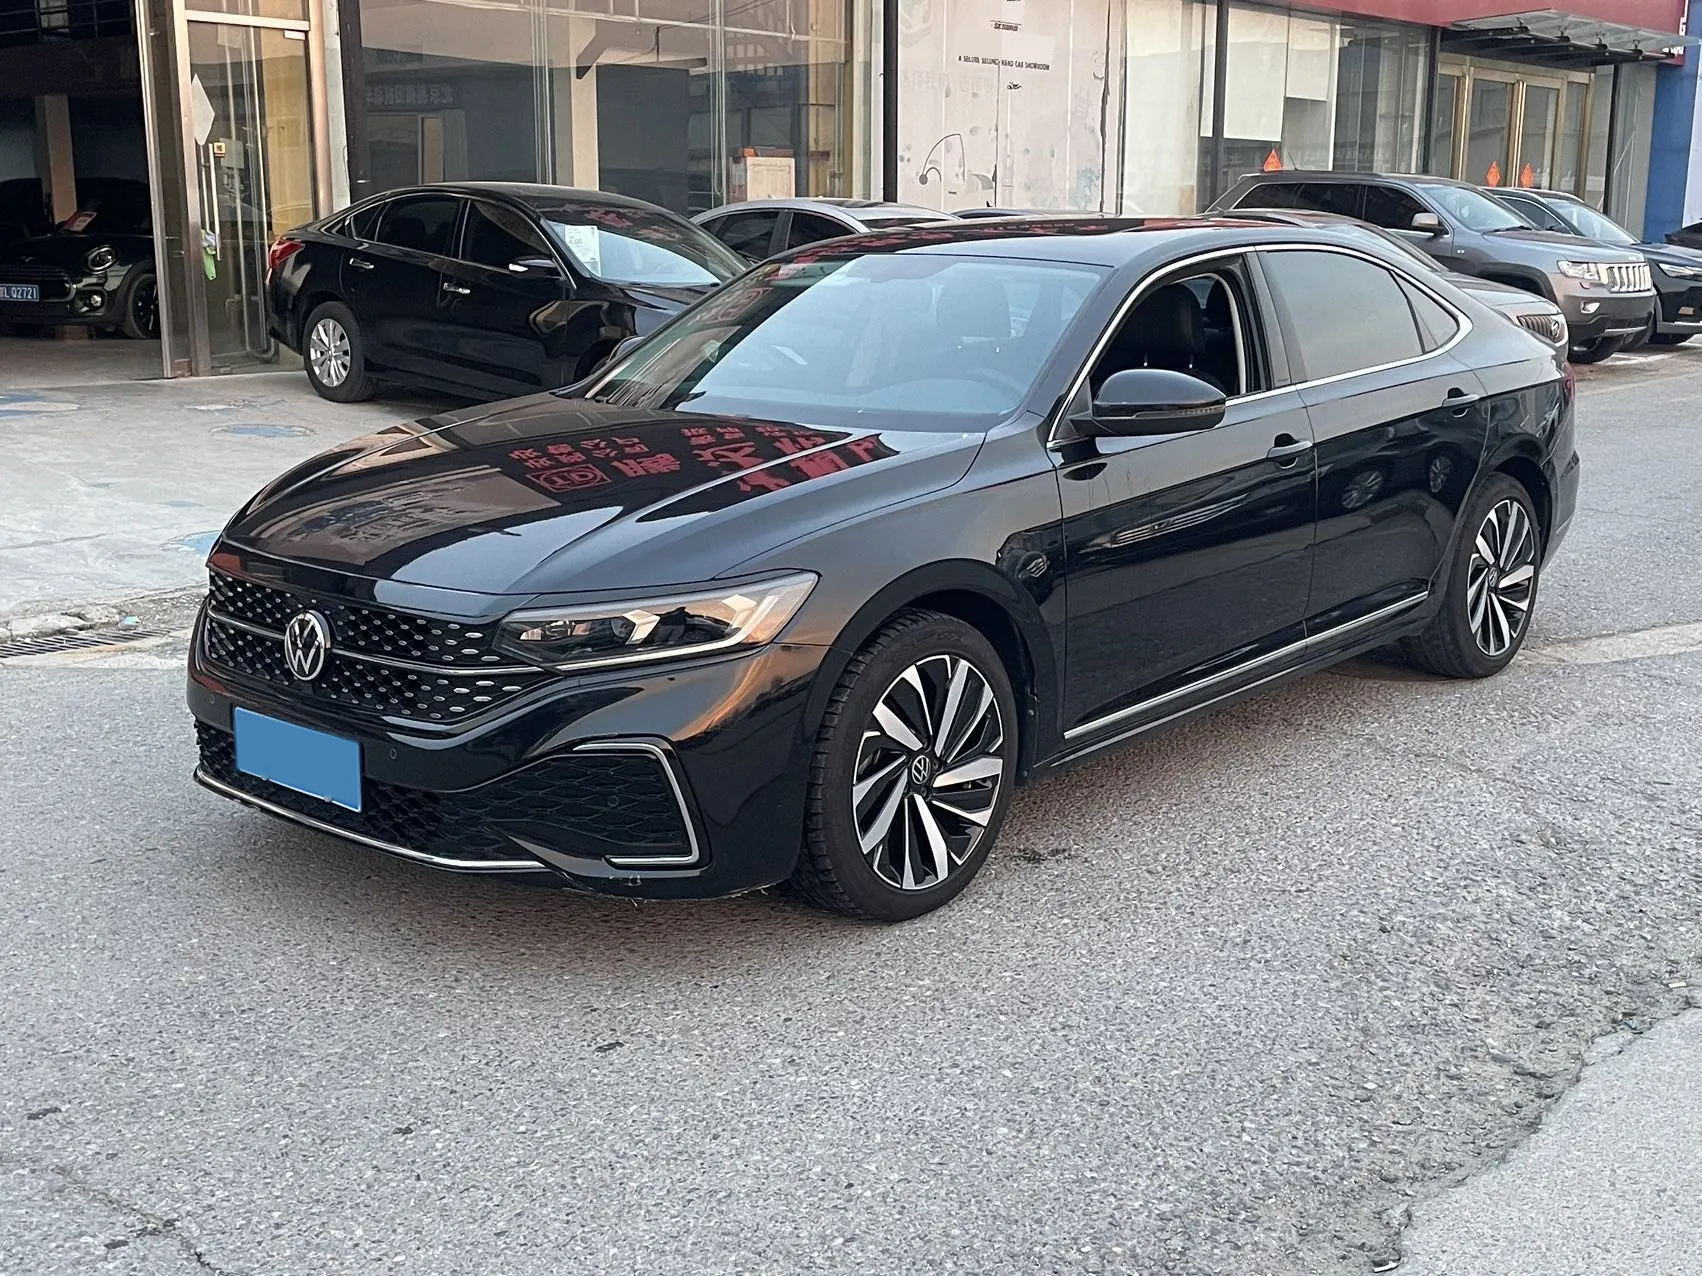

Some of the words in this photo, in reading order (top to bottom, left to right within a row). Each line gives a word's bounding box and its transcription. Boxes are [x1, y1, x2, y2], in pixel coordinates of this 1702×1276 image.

[981, 57, 1000, 66] SECOND
[1001, 59, 1014, 68] HAND
[1014, 60, 1024, 69] CAR
[1024, 61, 1050, 71] SHOWROOM
